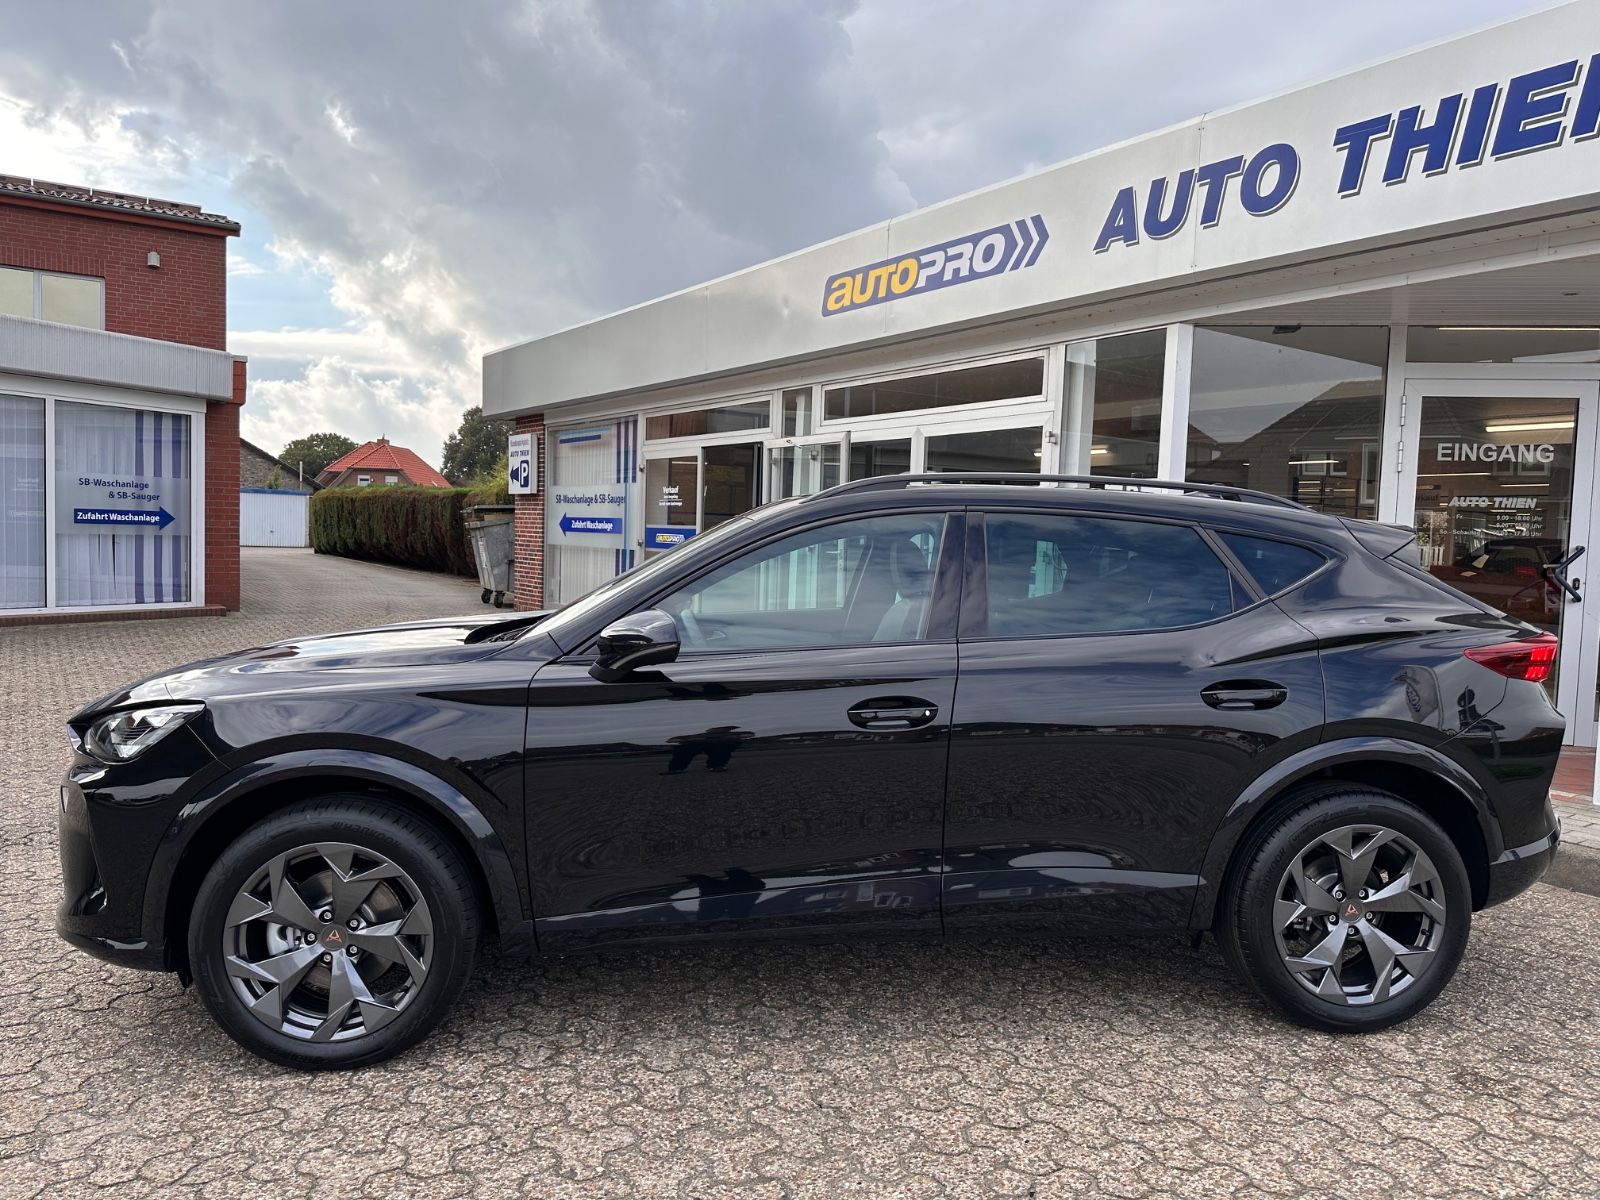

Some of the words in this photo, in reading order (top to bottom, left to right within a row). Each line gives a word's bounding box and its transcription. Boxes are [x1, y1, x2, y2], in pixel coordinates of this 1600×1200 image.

[1093, 142, 1301, 255] AUTO
[1436, 442, 1555, 463] EINGANG
[521, 462, 529, 485] P
[78, 477, 150, 490] SB-Waschanlage
[662, 485, 679, 494] Verkauf
[108, 491, 115, 499] &
[117, 491, 160, 502] SB-Sauger
[555, 494, 593, 506] SB-Waschanlage
[594, 494, 598, 504] &
[599, 494, 626, 506] SB-Sauger
[1448, 496, 1489, 508] AUTO
[1493, 497, 1538, 509] THIEN
[77, 512, 109, 521] Zufahrt
[109, 512, 160, 523] Waschanlage
[571, 520, 586, 529] Zufahrt
[586, 520, 613, 532] Waschanlage
